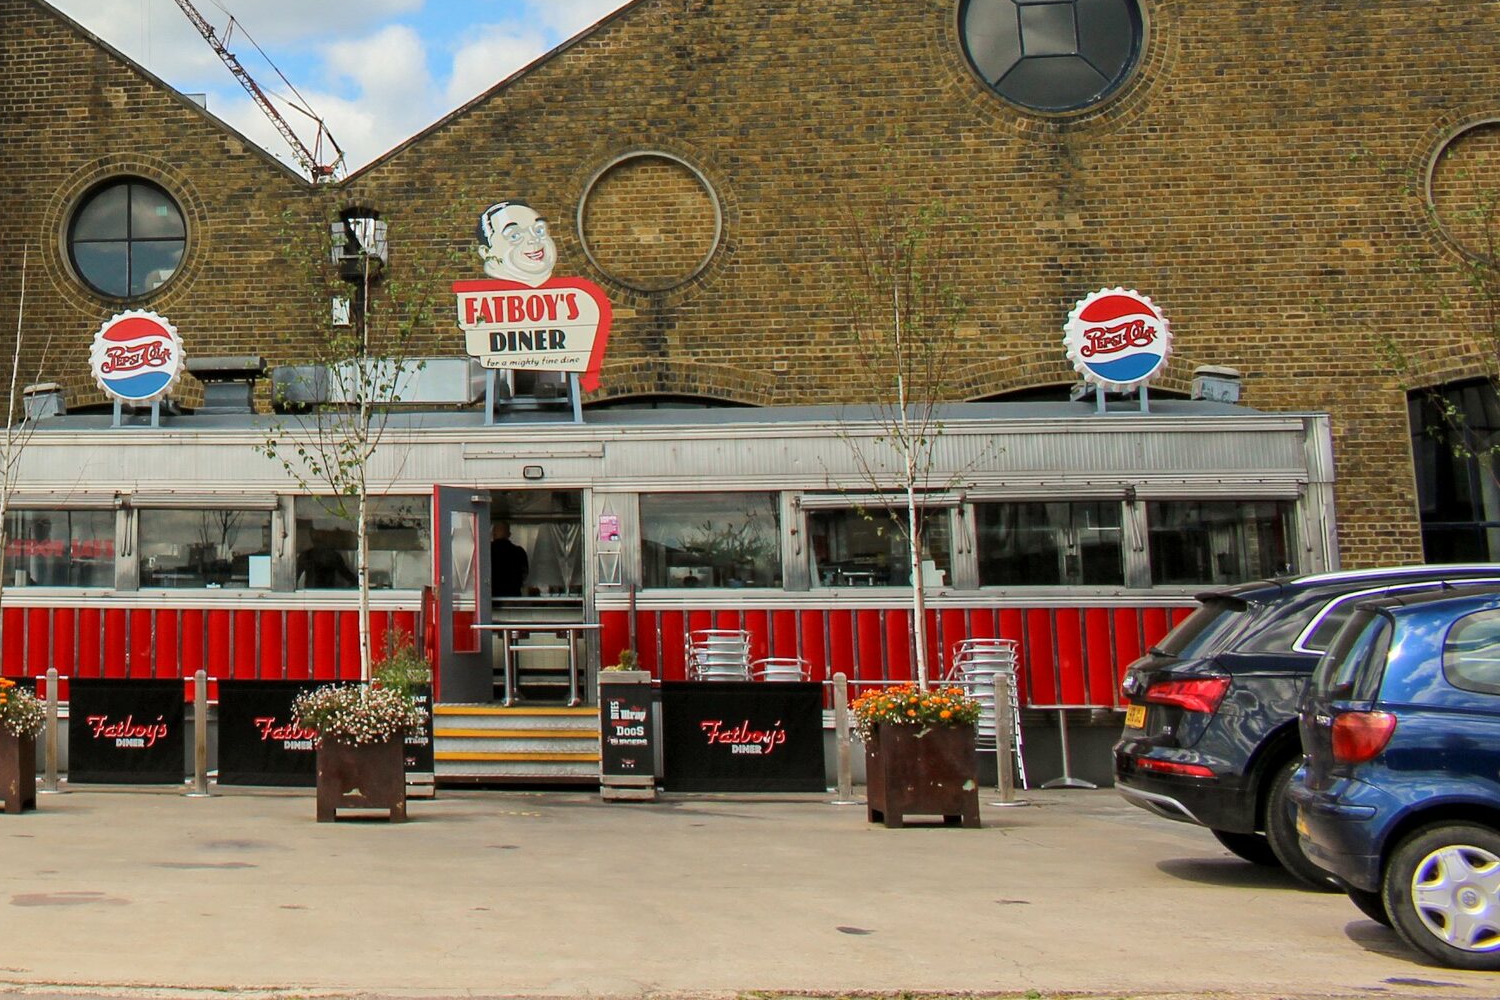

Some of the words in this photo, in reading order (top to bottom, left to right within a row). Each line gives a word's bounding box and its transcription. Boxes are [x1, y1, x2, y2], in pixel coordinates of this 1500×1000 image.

[465, 293, 580, 325] FATBOY'S
[489, 329, 566, 352] DINER
[486, 358, 498, 367] for
[509, 357, 539, 367] mighty
[542, 356, 558, 365] fine
[560, 356, 580, 364] dine
[85, 714, 167, 747] Fatboy's
[254, 716, 319, 740] Fatbo
[700, 719, 786, 754] Fatboy's
[116, 738, 144, 747] DINER
[284, 740, 313, 750] DINER
[731, 744, 762, 754] DINER
